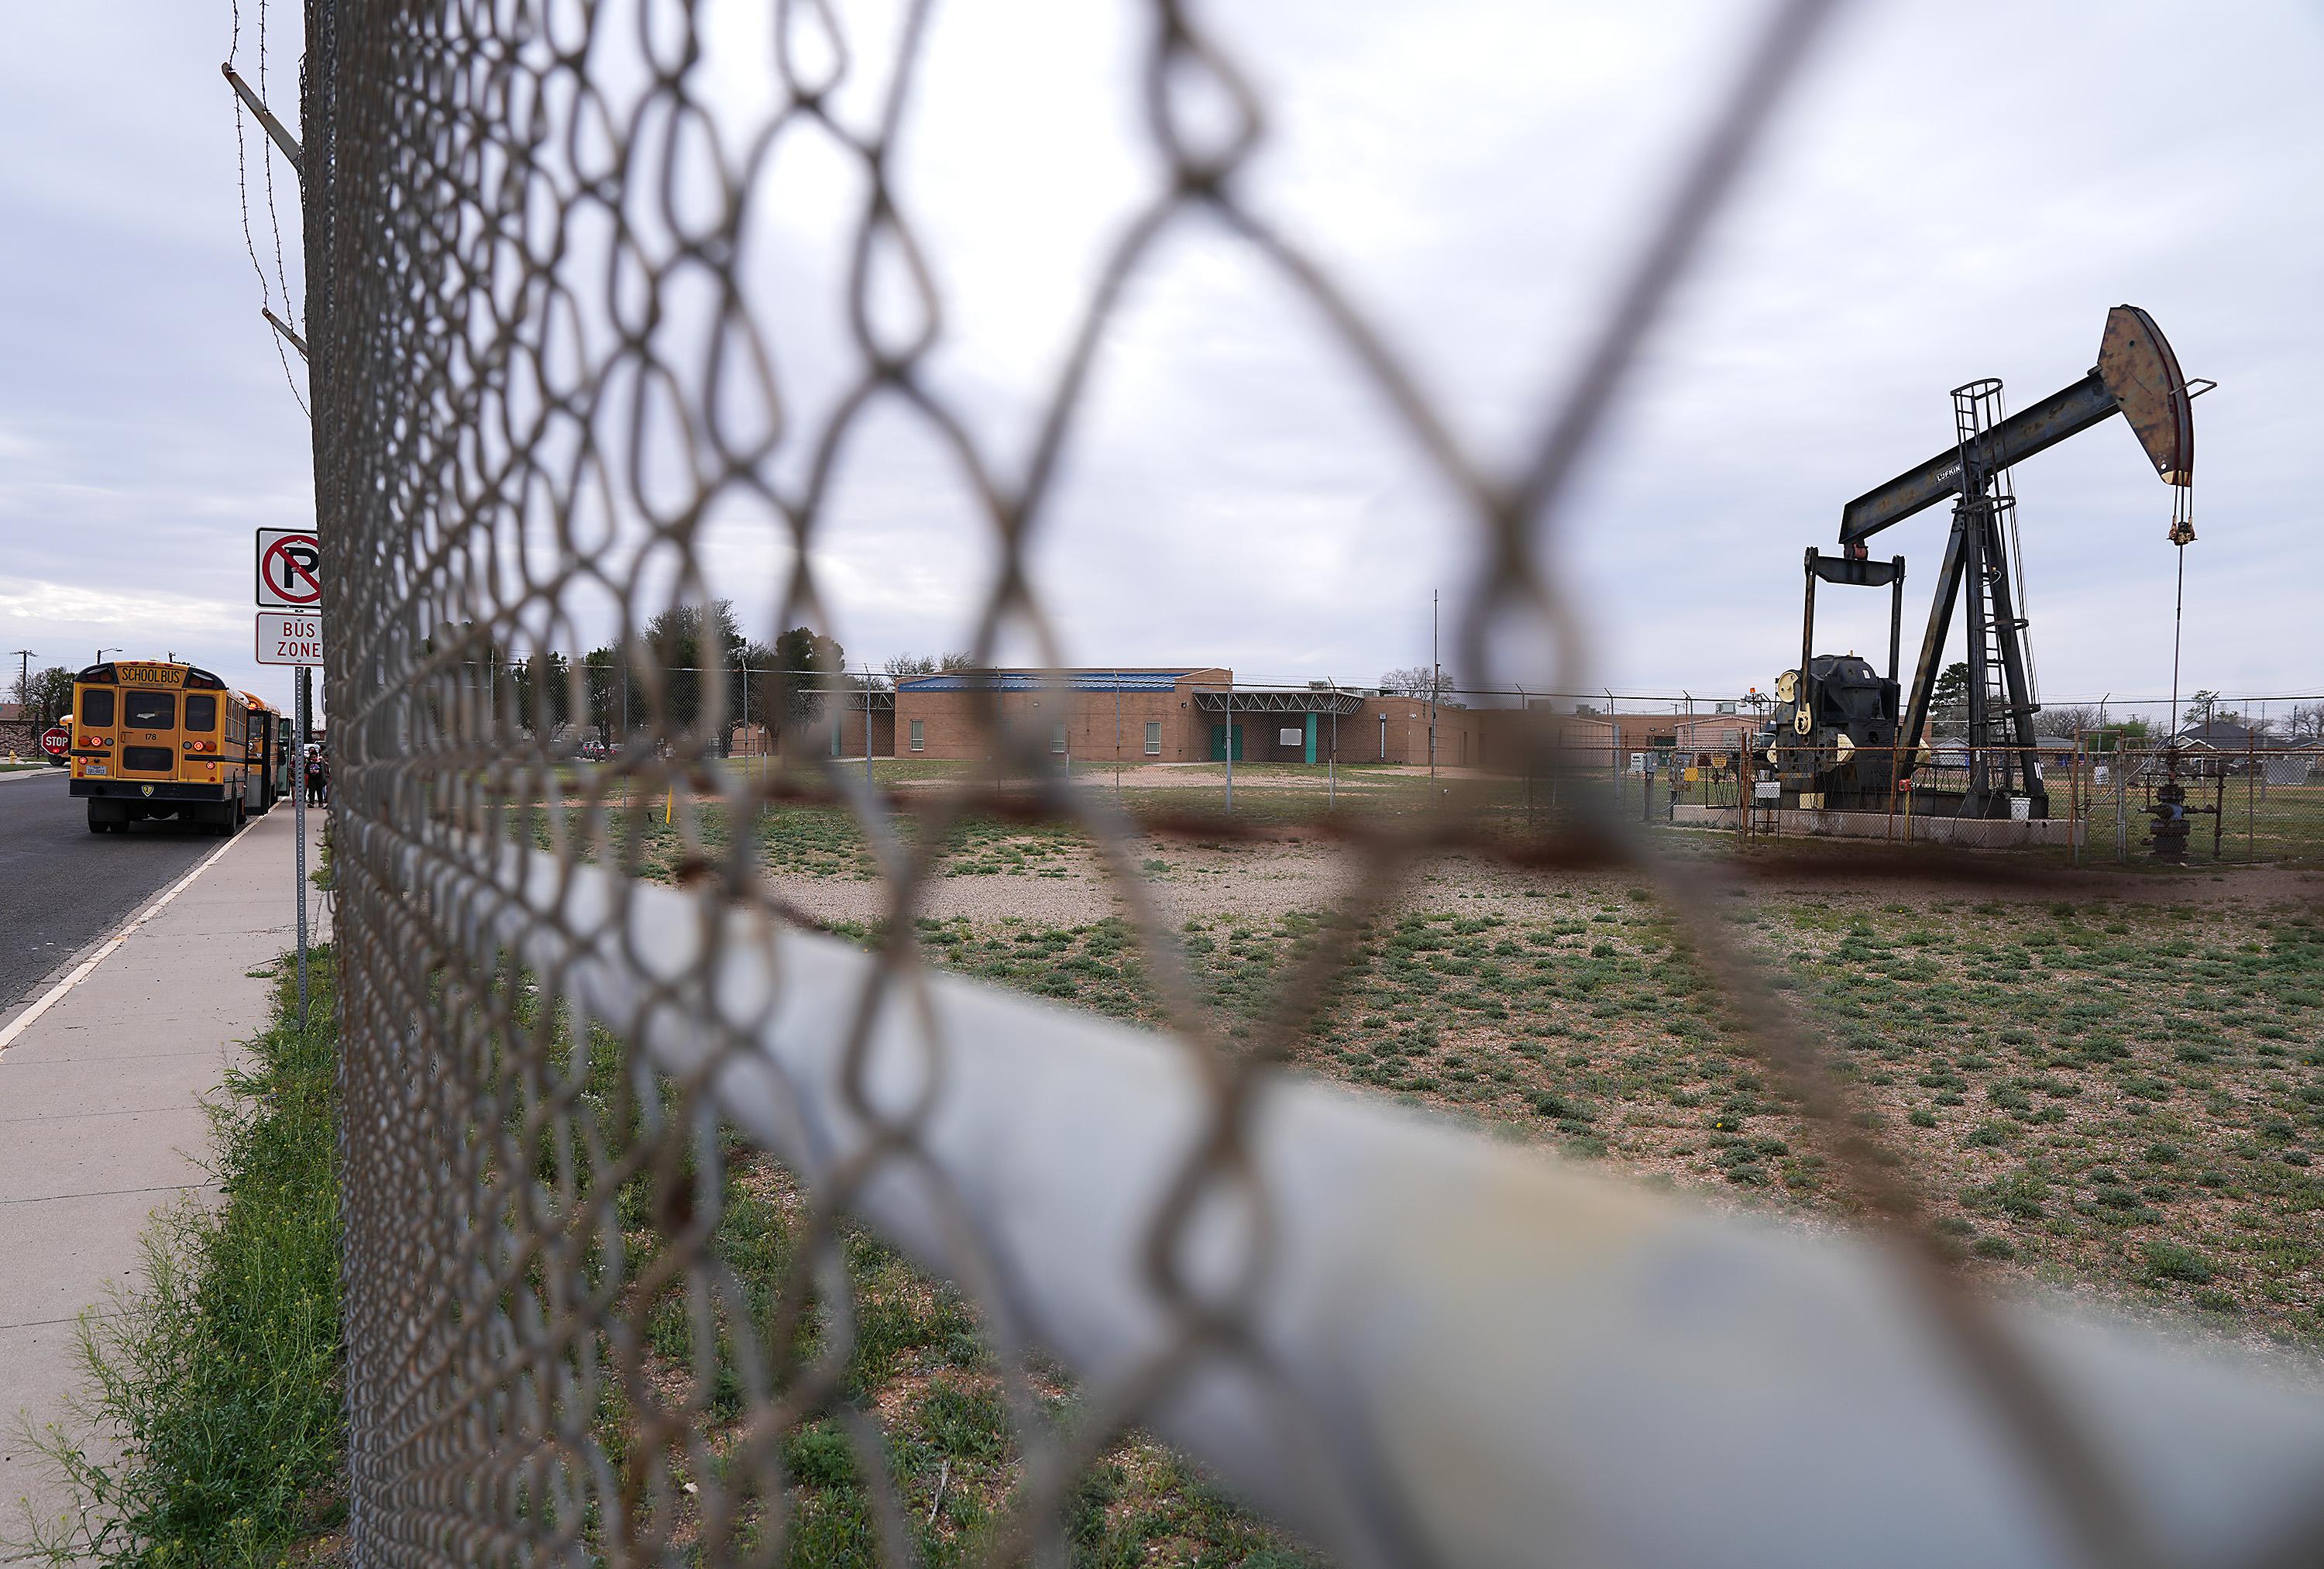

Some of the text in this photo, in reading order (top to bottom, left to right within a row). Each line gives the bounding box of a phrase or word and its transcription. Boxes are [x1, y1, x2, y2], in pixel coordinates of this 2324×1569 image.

[1937, 465, 1961, 481] LUFKIN
[283, 621, 315, 638] BUS
[277, 641, 321, 657] ZONE
[46, 736, 68, 747] STOP
